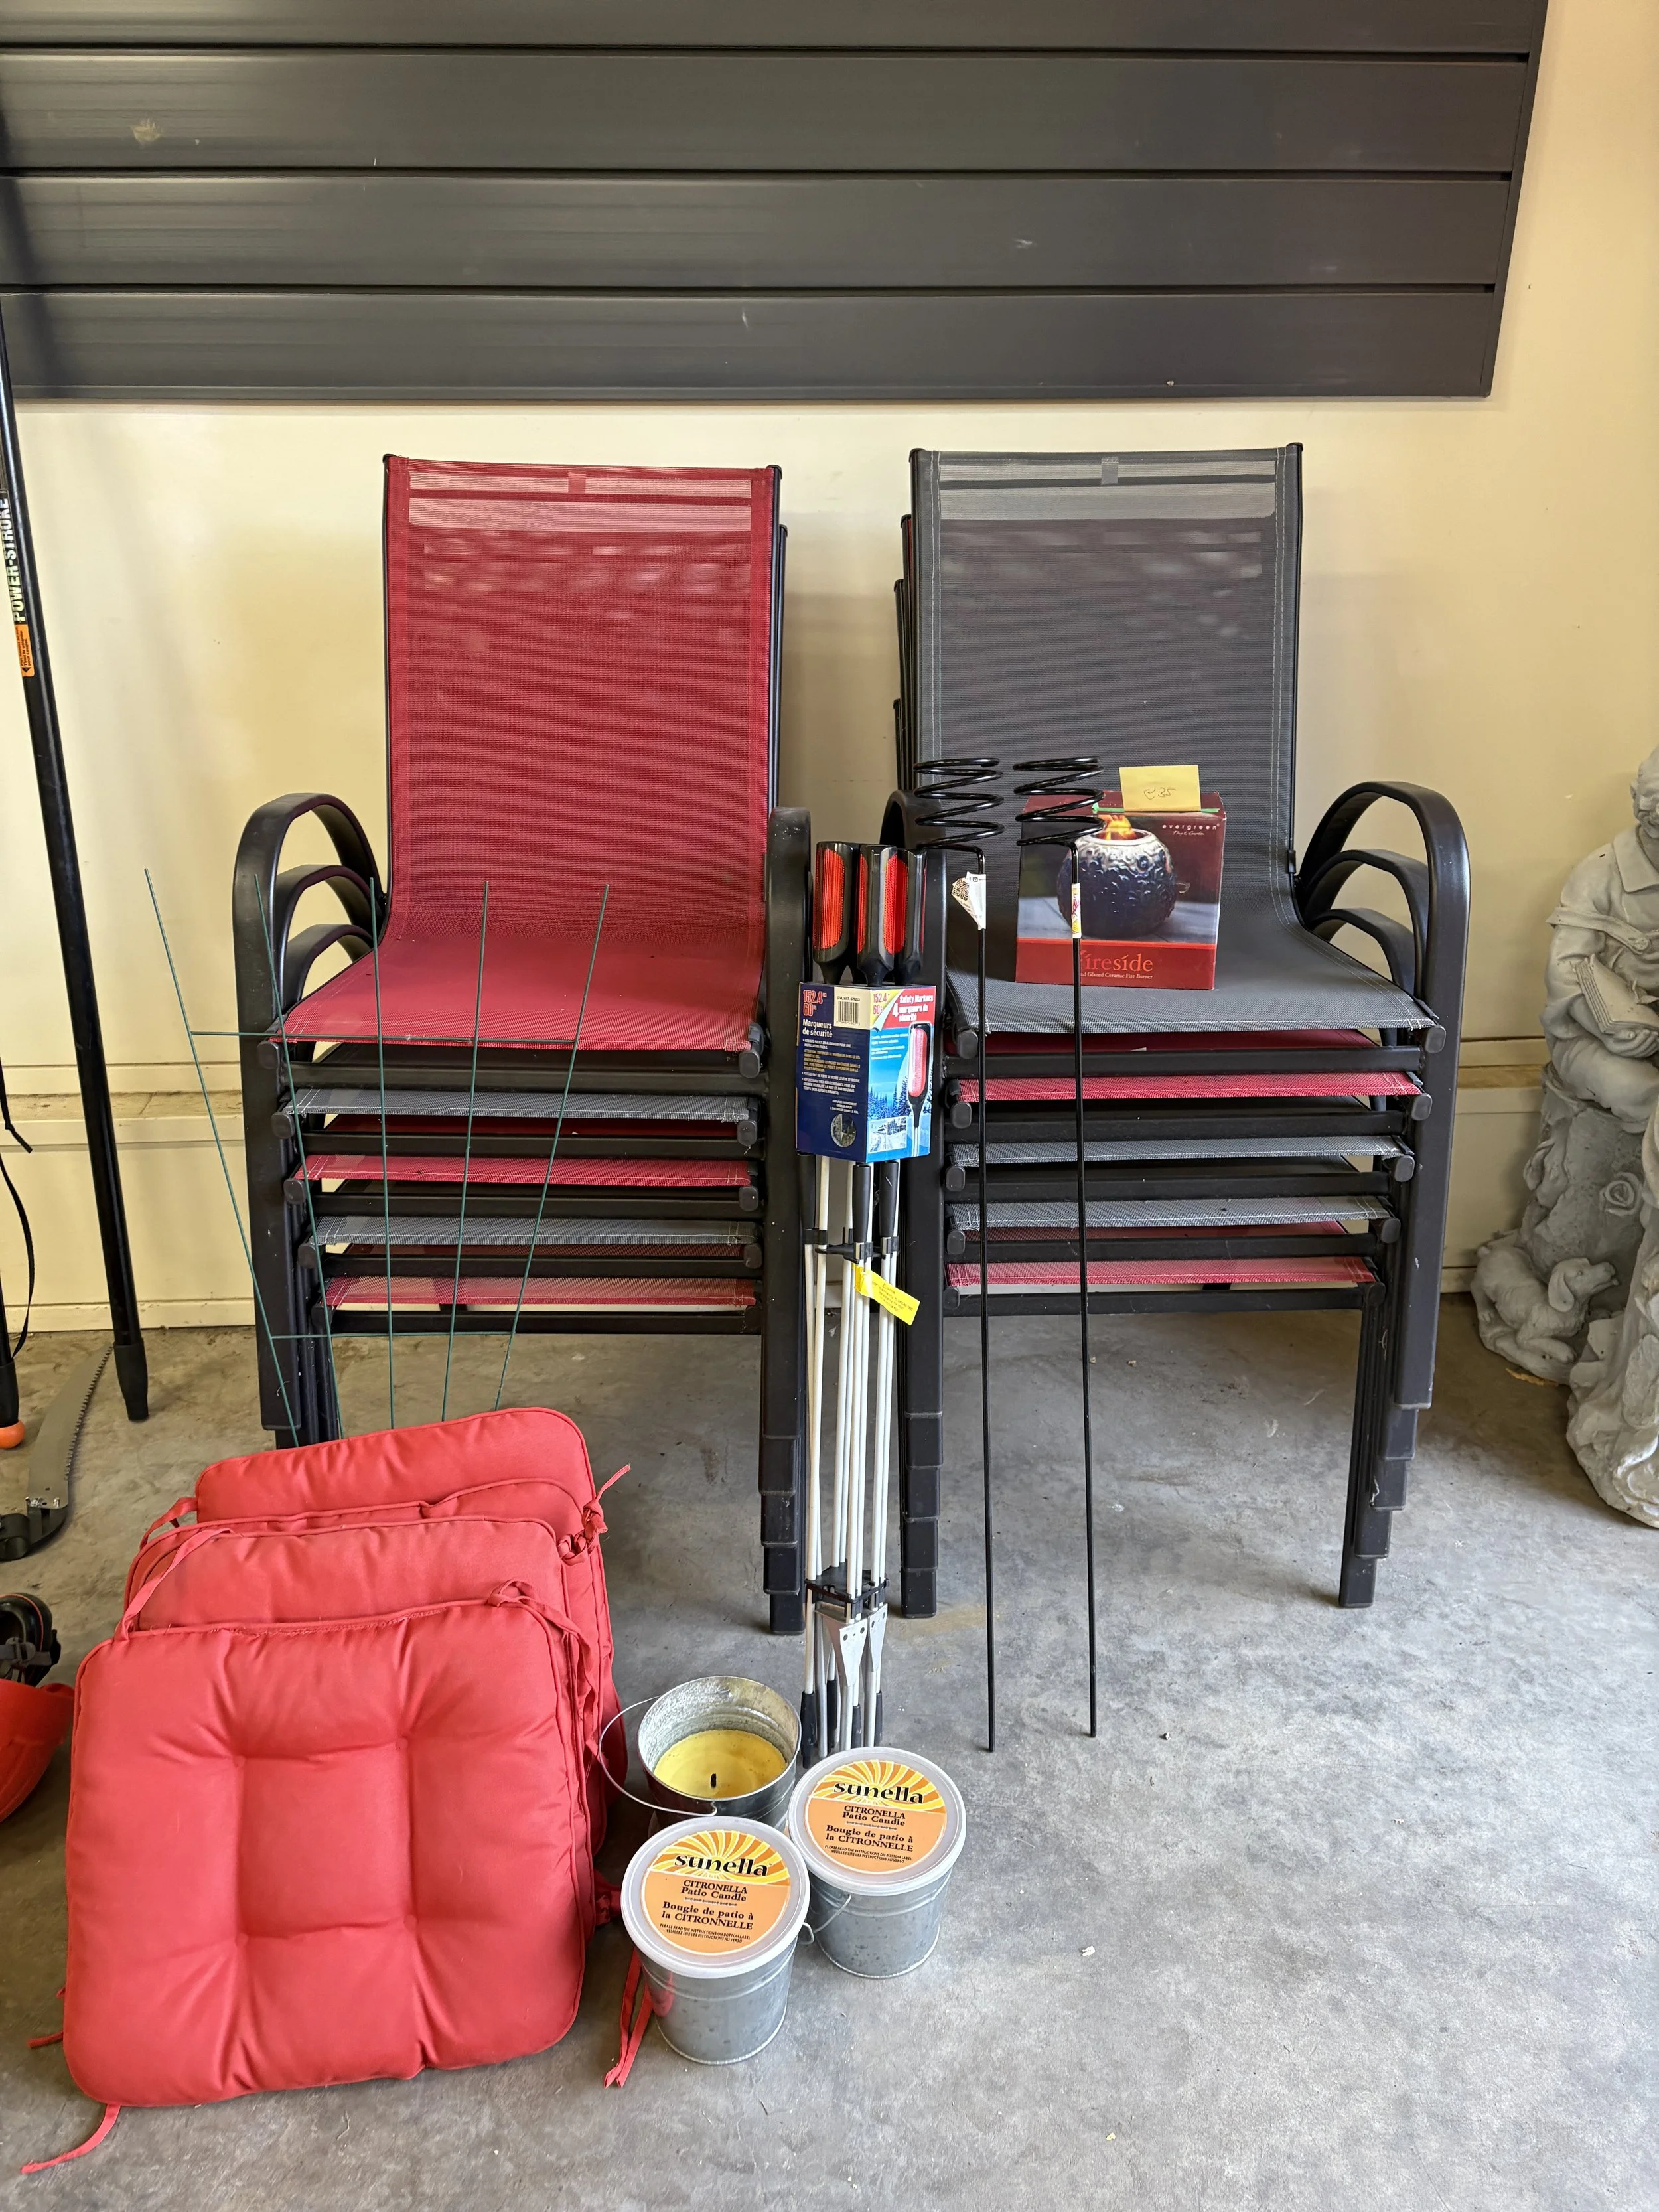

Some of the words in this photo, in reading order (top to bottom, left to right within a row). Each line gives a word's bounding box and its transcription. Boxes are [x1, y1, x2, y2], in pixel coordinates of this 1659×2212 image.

[892, 1003, 899, 1017] 4
[803, 1019, 832, 1029] Marqueurs
[810, 1029, 833, 1038] sécurité
[833, 1783, 923, 1804] sunella
[842, 1812, 867, 1821] Patio
[871, 1816, 905, 1826] Candle
[844, 1805, 905, 1820] CITRONELLA
[826, 1825, 861, 1836] Bougie
[879, 1833, 904, 1842] patio
[839, 1836, 913, 1852] CITRONNELLE
[674, 1855, 768, 1877] sunella
[681, 1886, 707, 1897] Patio
[711, 1891, 746, 1901] Candle
[684, 1880, 747, 1894] CITRONELLA
[662, 1901, 699, 1913] Bougie
[702, 1907, 714, 1915] de
[717, 1909, 745, 1919] patio
[674, 1913, 753, 1930] CITRONNELLE
